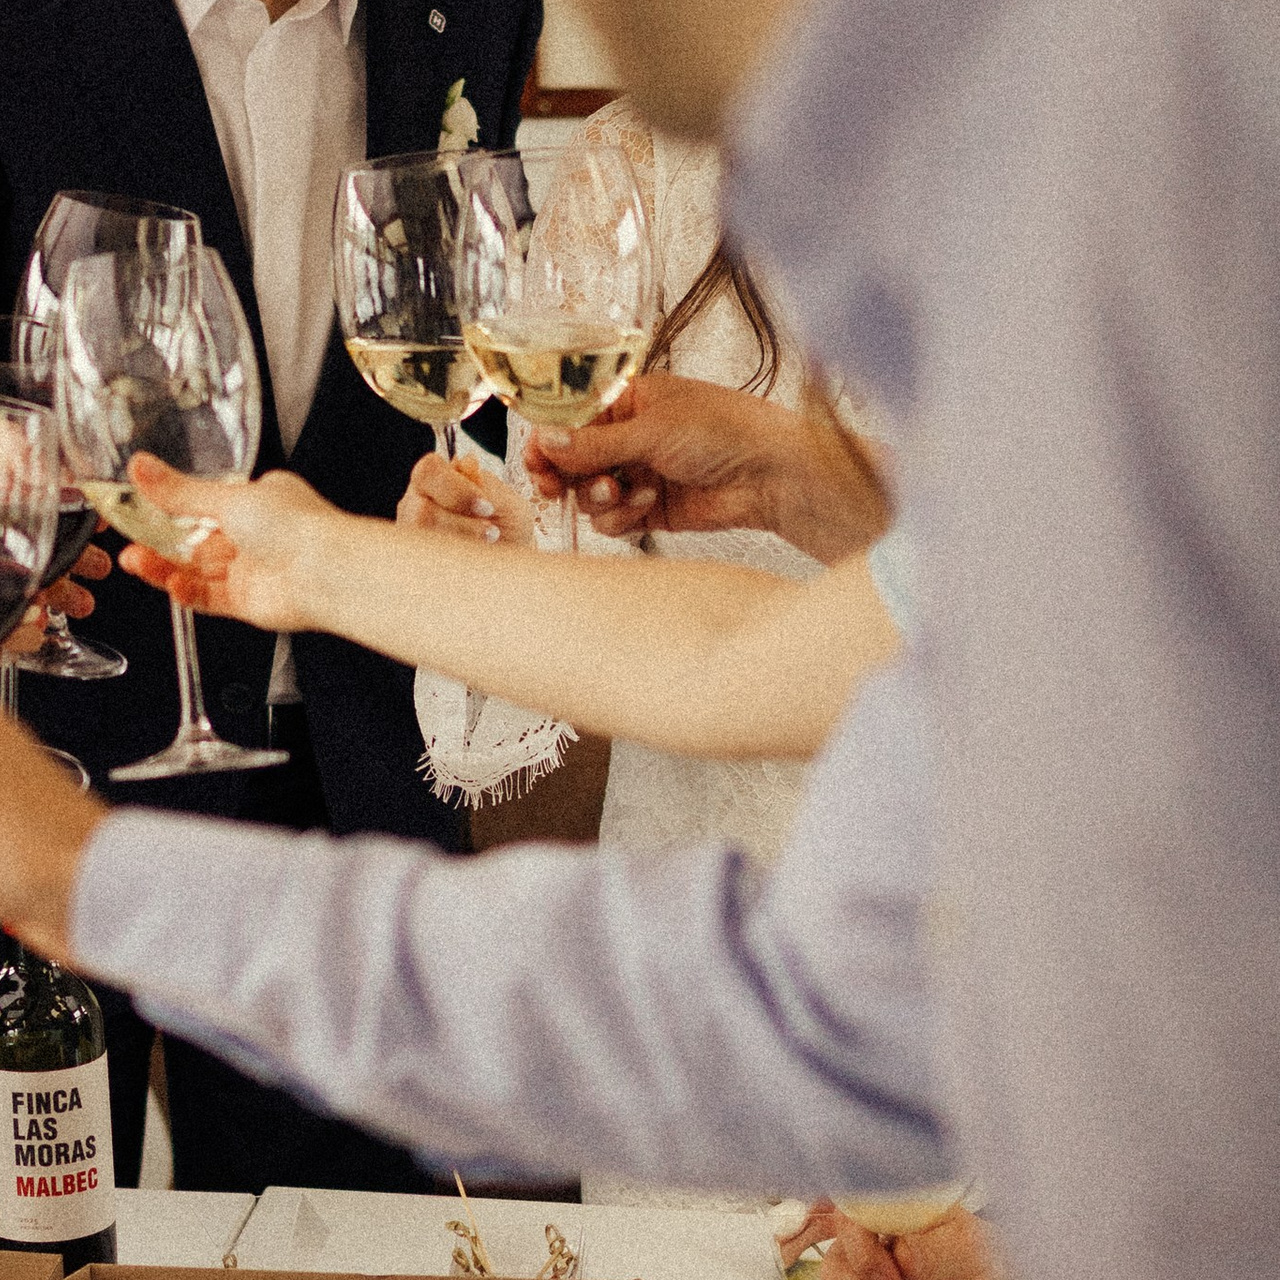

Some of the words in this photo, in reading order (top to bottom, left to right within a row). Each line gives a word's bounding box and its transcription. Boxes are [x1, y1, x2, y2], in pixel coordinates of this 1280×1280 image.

[12, 1087, 82, 1114] FINCA
[13, 1117, 58, 1141] LAS
[15, 1135, 96, 1167] MORAS
[16, 1167, 98, 1197] MALBEC
